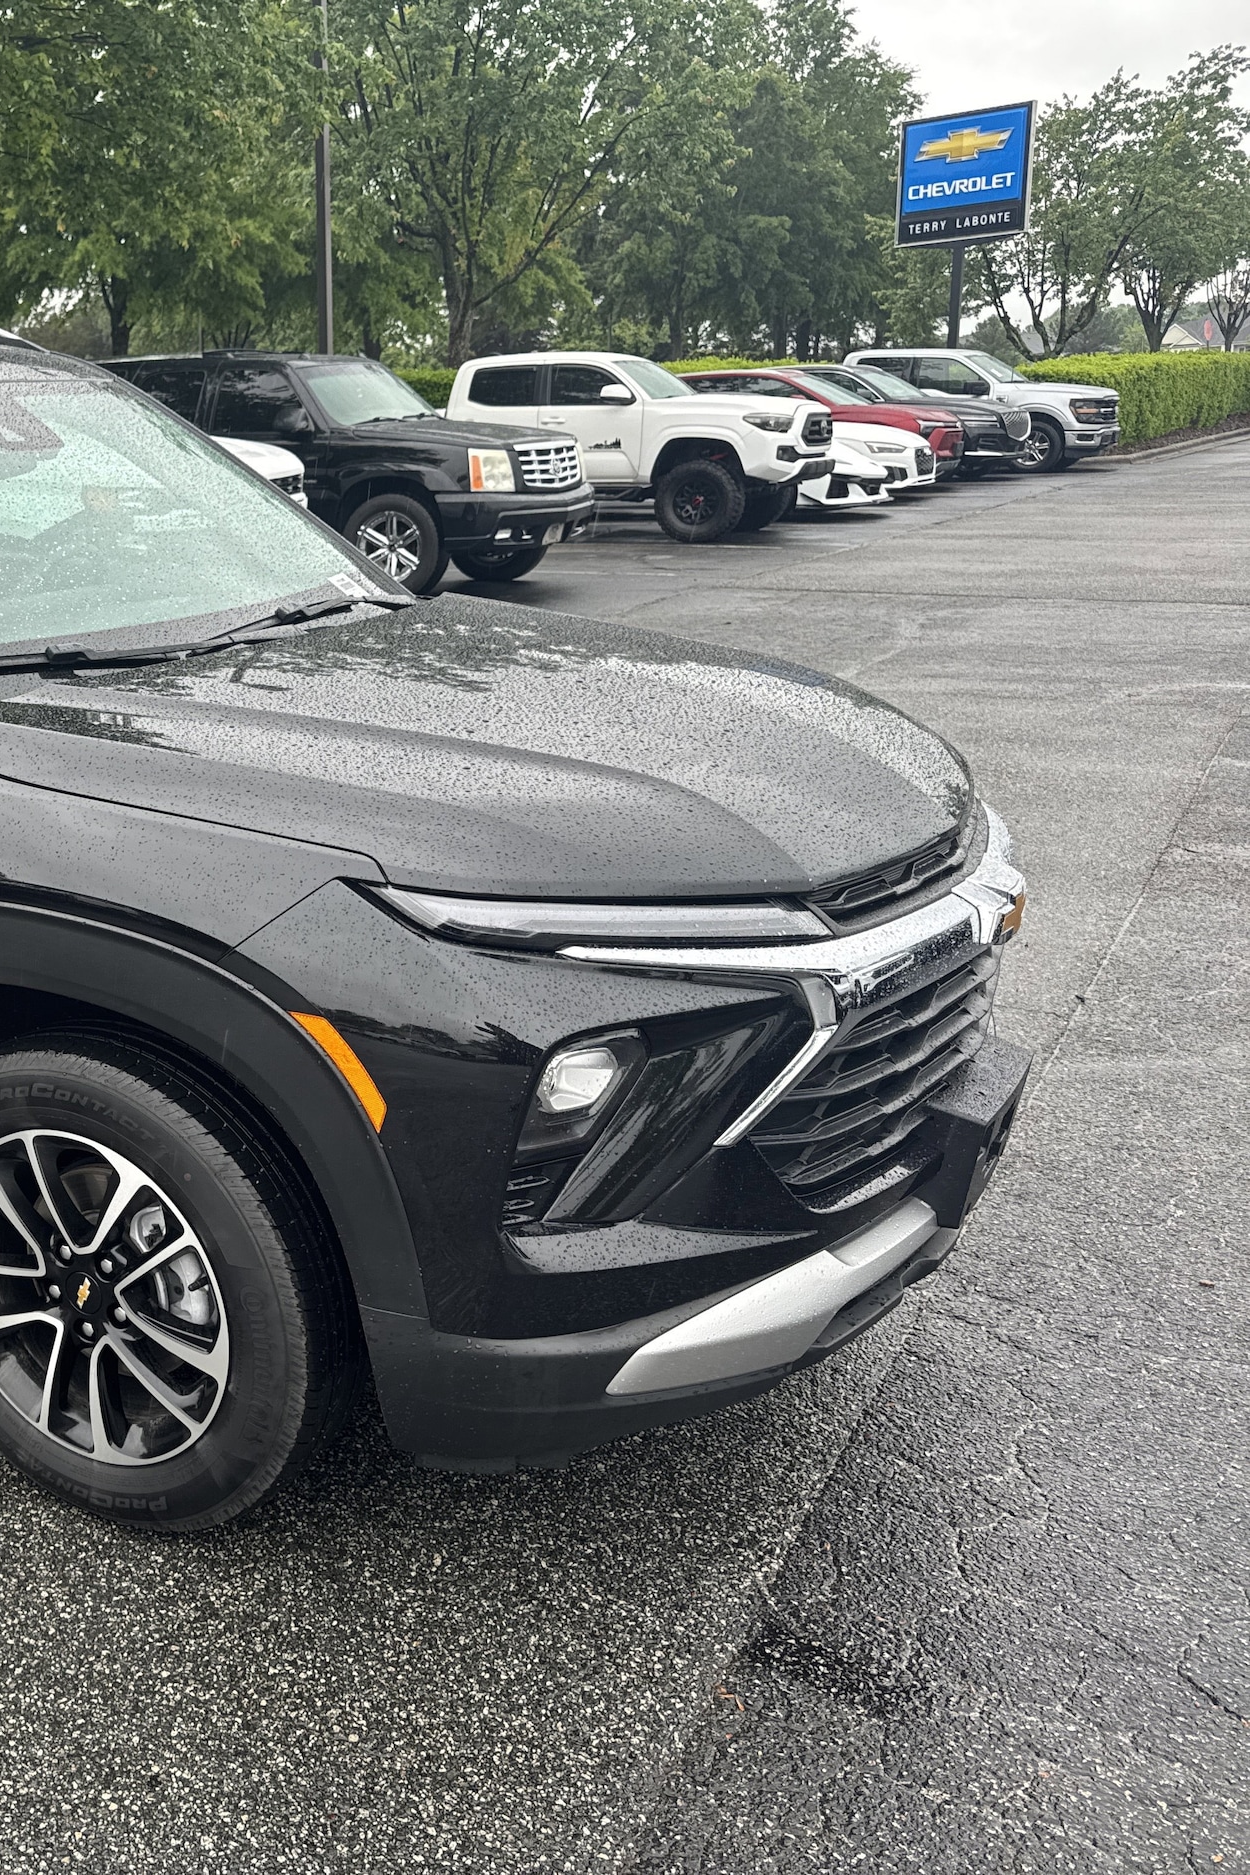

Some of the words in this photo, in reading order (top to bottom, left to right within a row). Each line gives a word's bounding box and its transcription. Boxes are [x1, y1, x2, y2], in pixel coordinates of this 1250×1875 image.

[908, 172, 1015, 200] CHEVROLET
[908, 220, 947, 235] TERRY
[955, 211, 1011, 229] LABONTE
